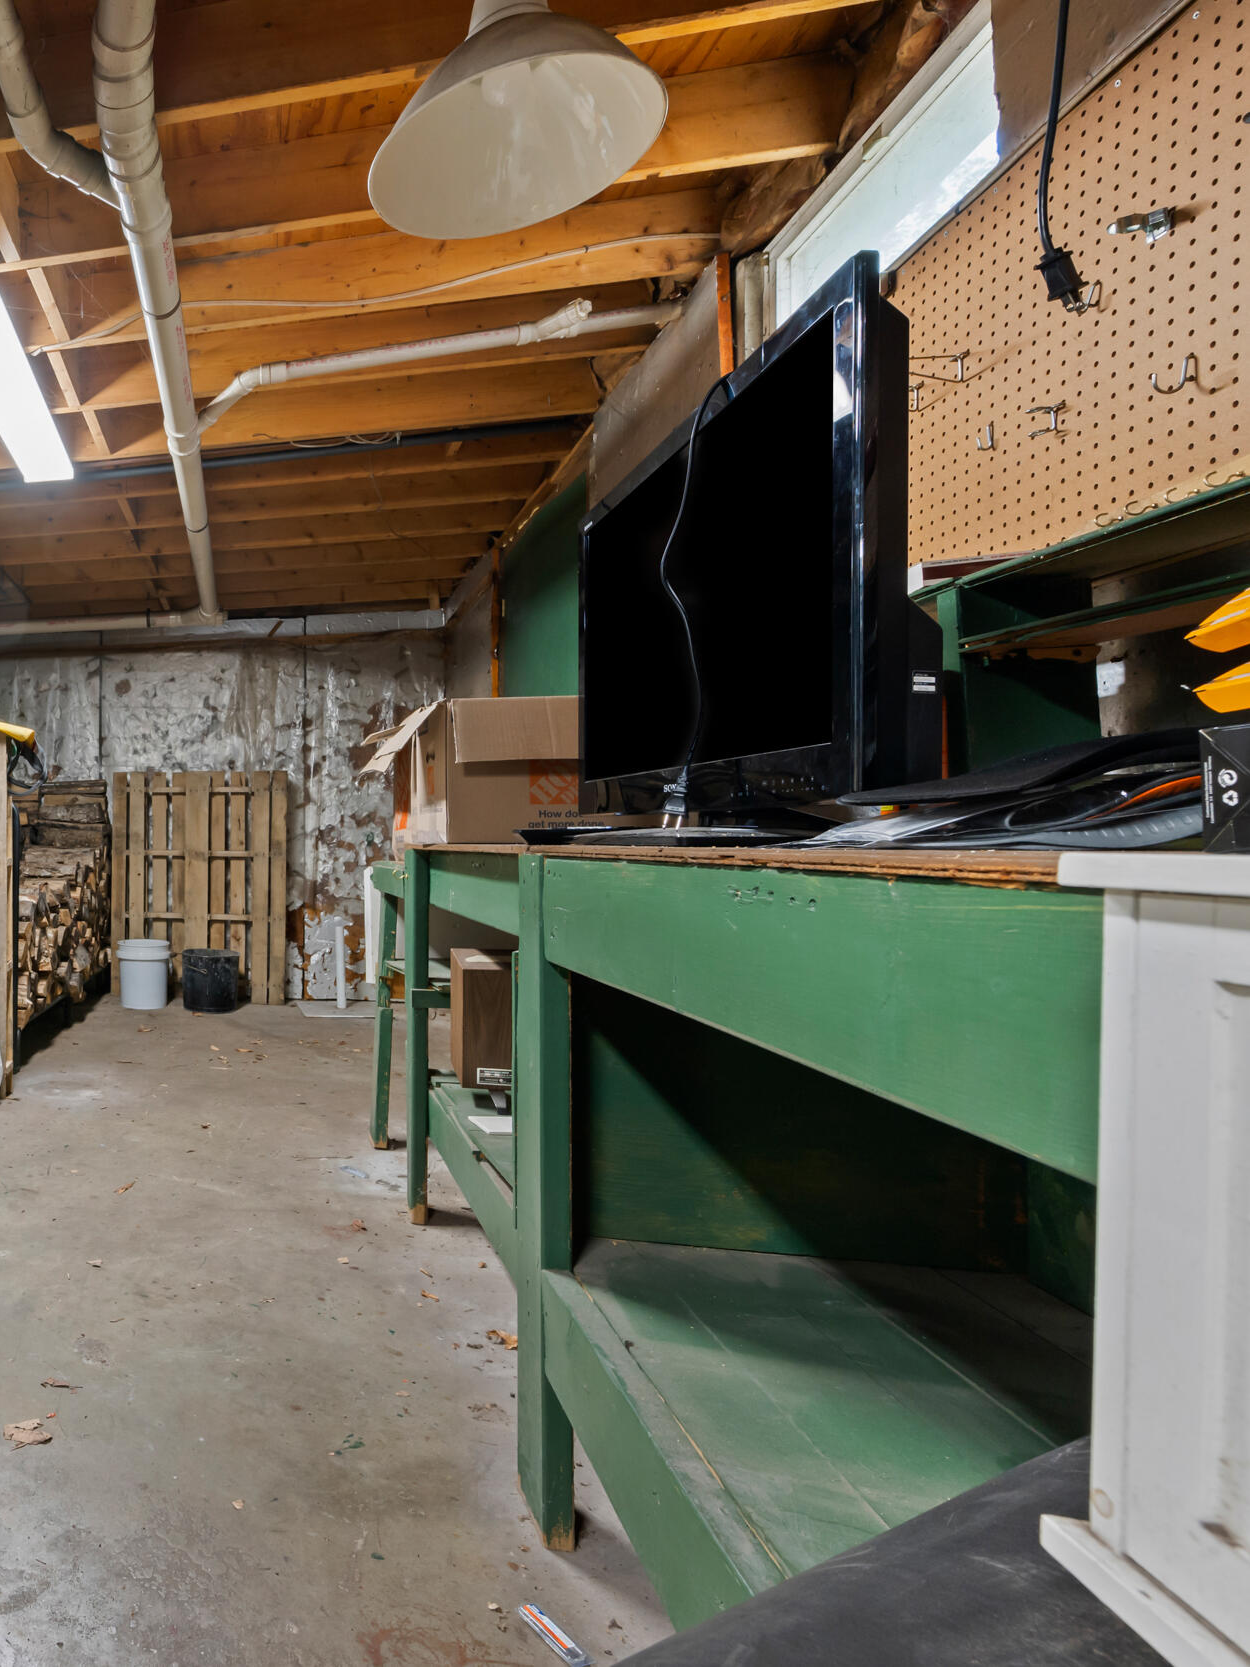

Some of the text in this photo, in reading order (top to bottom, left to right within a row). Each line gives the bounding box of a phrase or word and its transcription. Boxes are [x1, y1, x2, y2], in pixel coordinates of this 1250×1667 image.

[663, 783, 678, 793] SON
[538, 809, 562, 818] How
[528, 820, 545, 829] get
[548, 821, 575, 829] more
